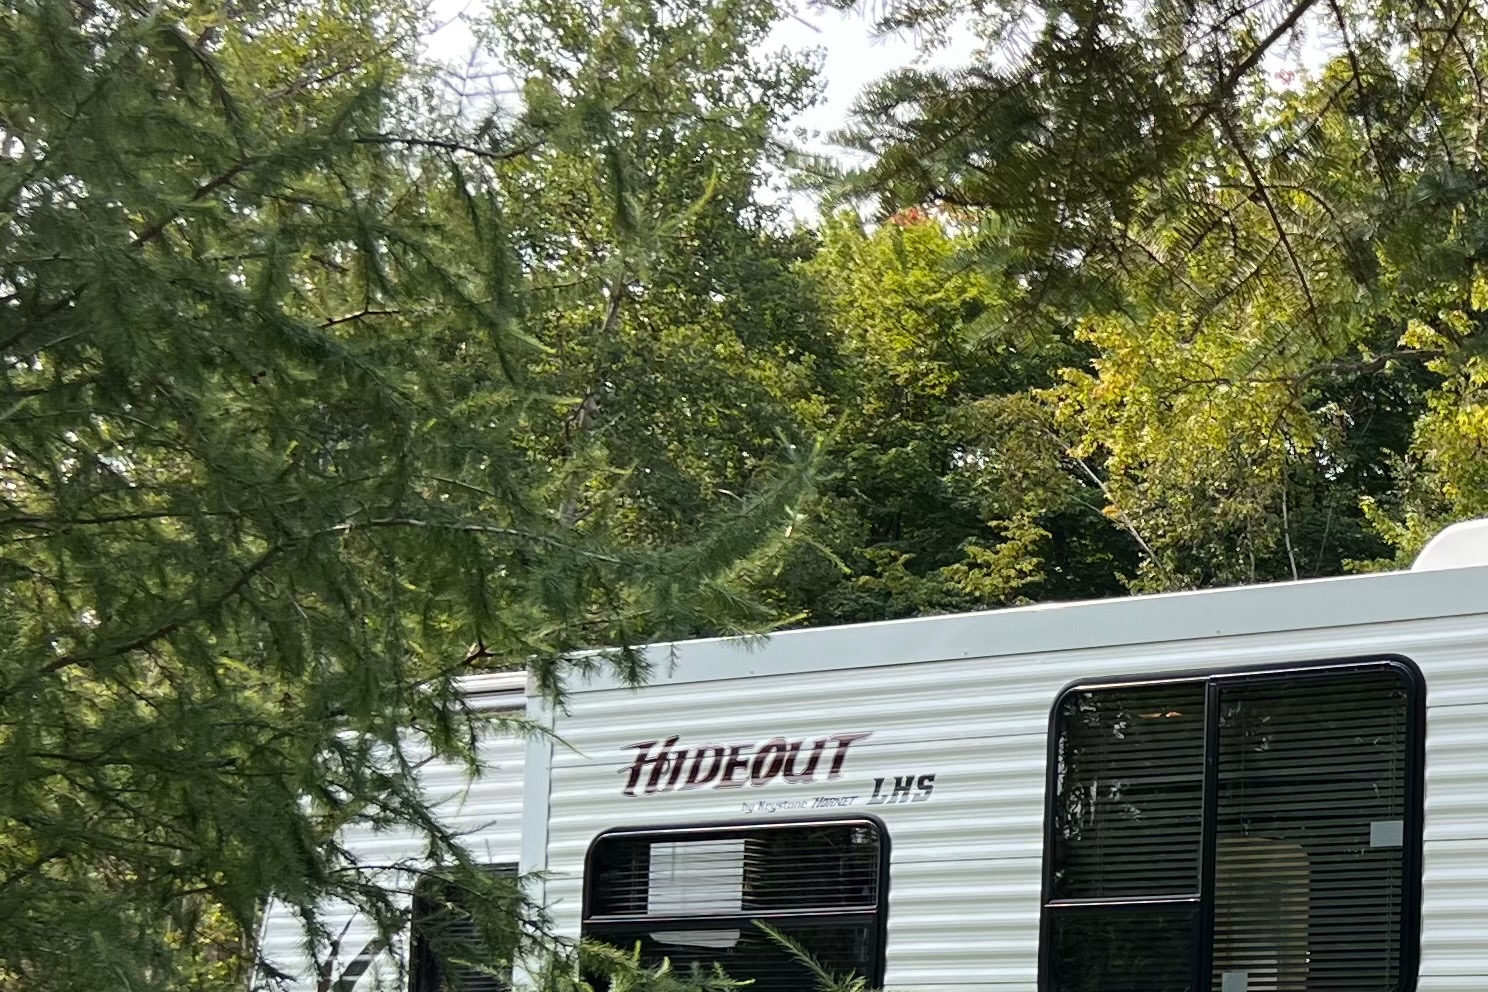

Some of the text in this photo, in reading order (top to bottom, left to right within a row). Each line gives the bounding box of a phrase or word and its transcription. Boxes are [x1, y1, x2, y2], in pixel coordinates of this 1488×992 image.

[618, 731, 874, 797] HIDEOUT
[866, 773, 936, 805] LHS
[758, 800, 808, 813] Keystone
